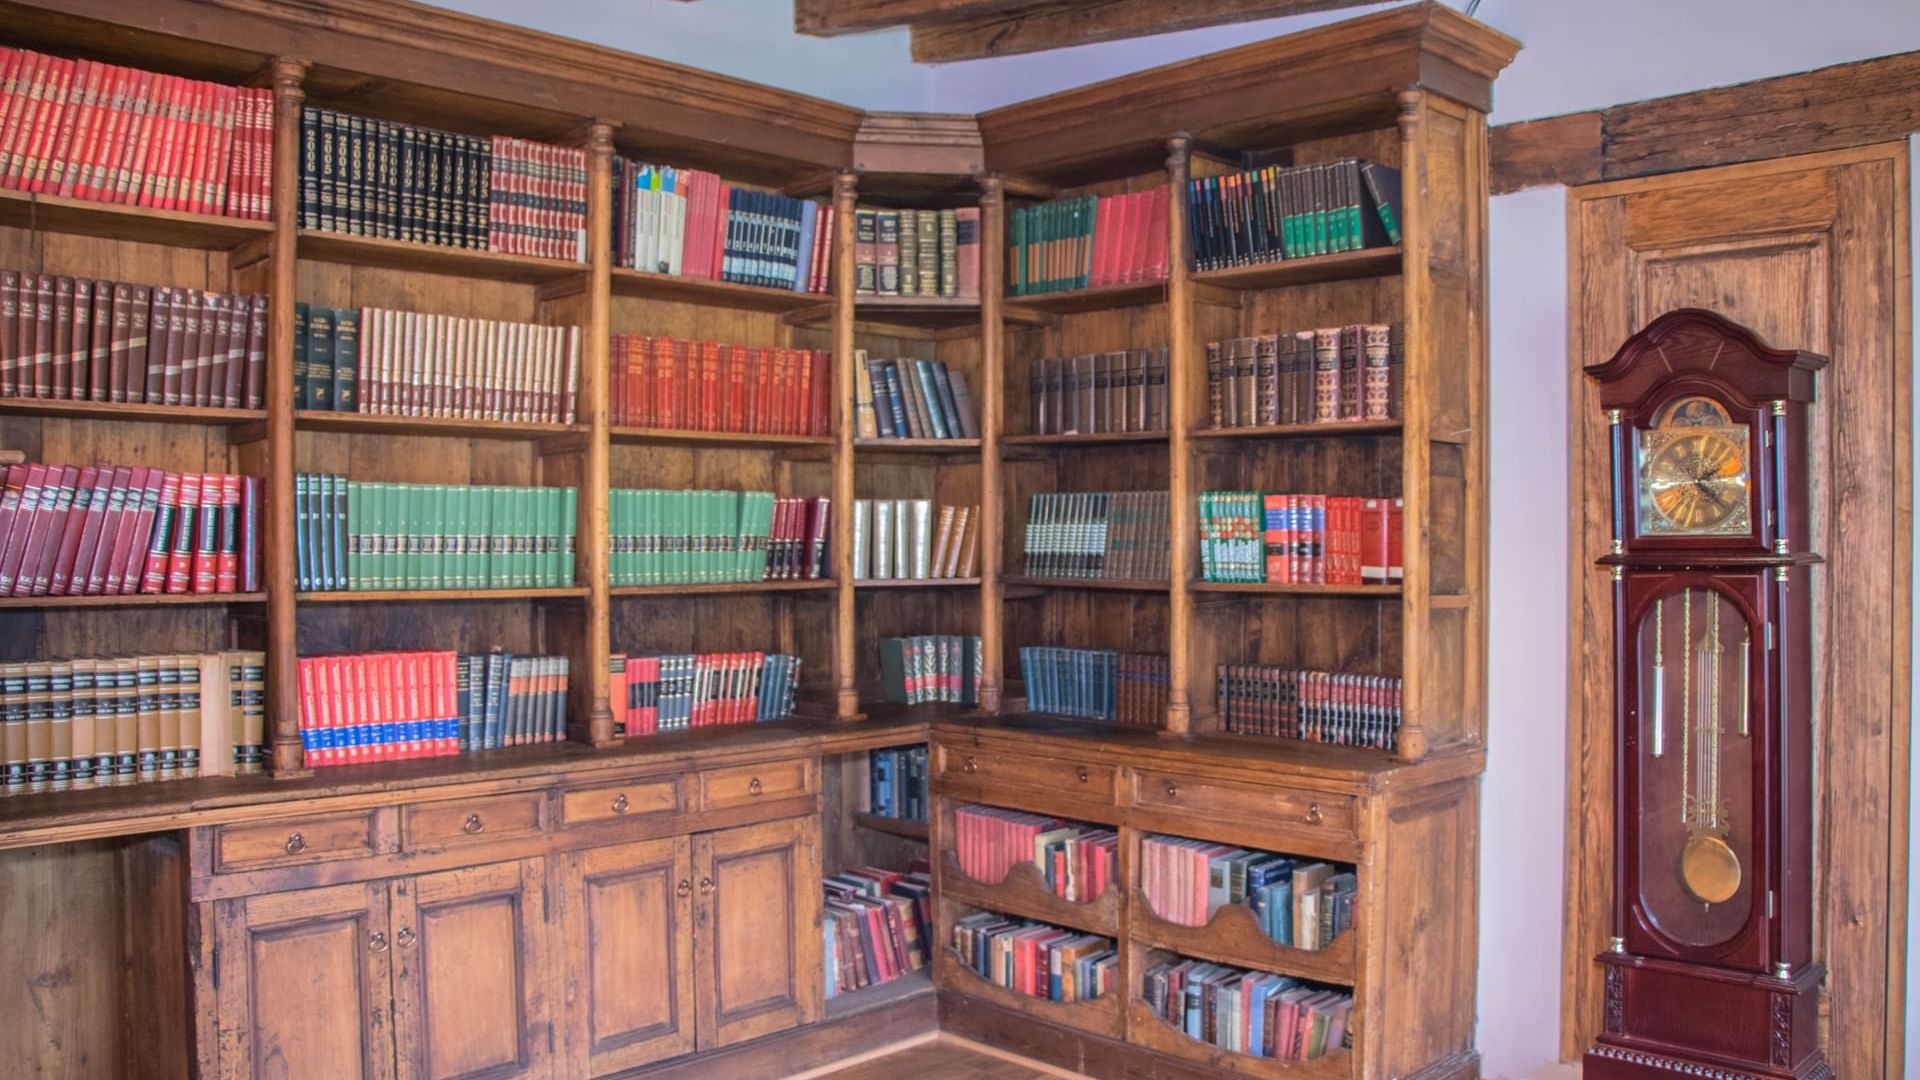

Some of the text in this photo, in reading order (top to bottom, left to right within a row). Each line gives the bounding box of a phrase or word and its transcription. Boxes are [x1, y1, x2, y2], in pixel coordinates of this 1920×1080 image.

[307, 129, 316, 172] 2006
[324, 133, 332, 175] 2005
[338, 135, 347, 177] 2004
[353, 138, 361, 181] 2003
[367, 140, 376, 182] 2002
[380, 143, 388, 184] 2001
[390, 146, 398, 186] 2000
[404, 148, 413, 188] 1999
[430, 153, 438, 192] 1997
